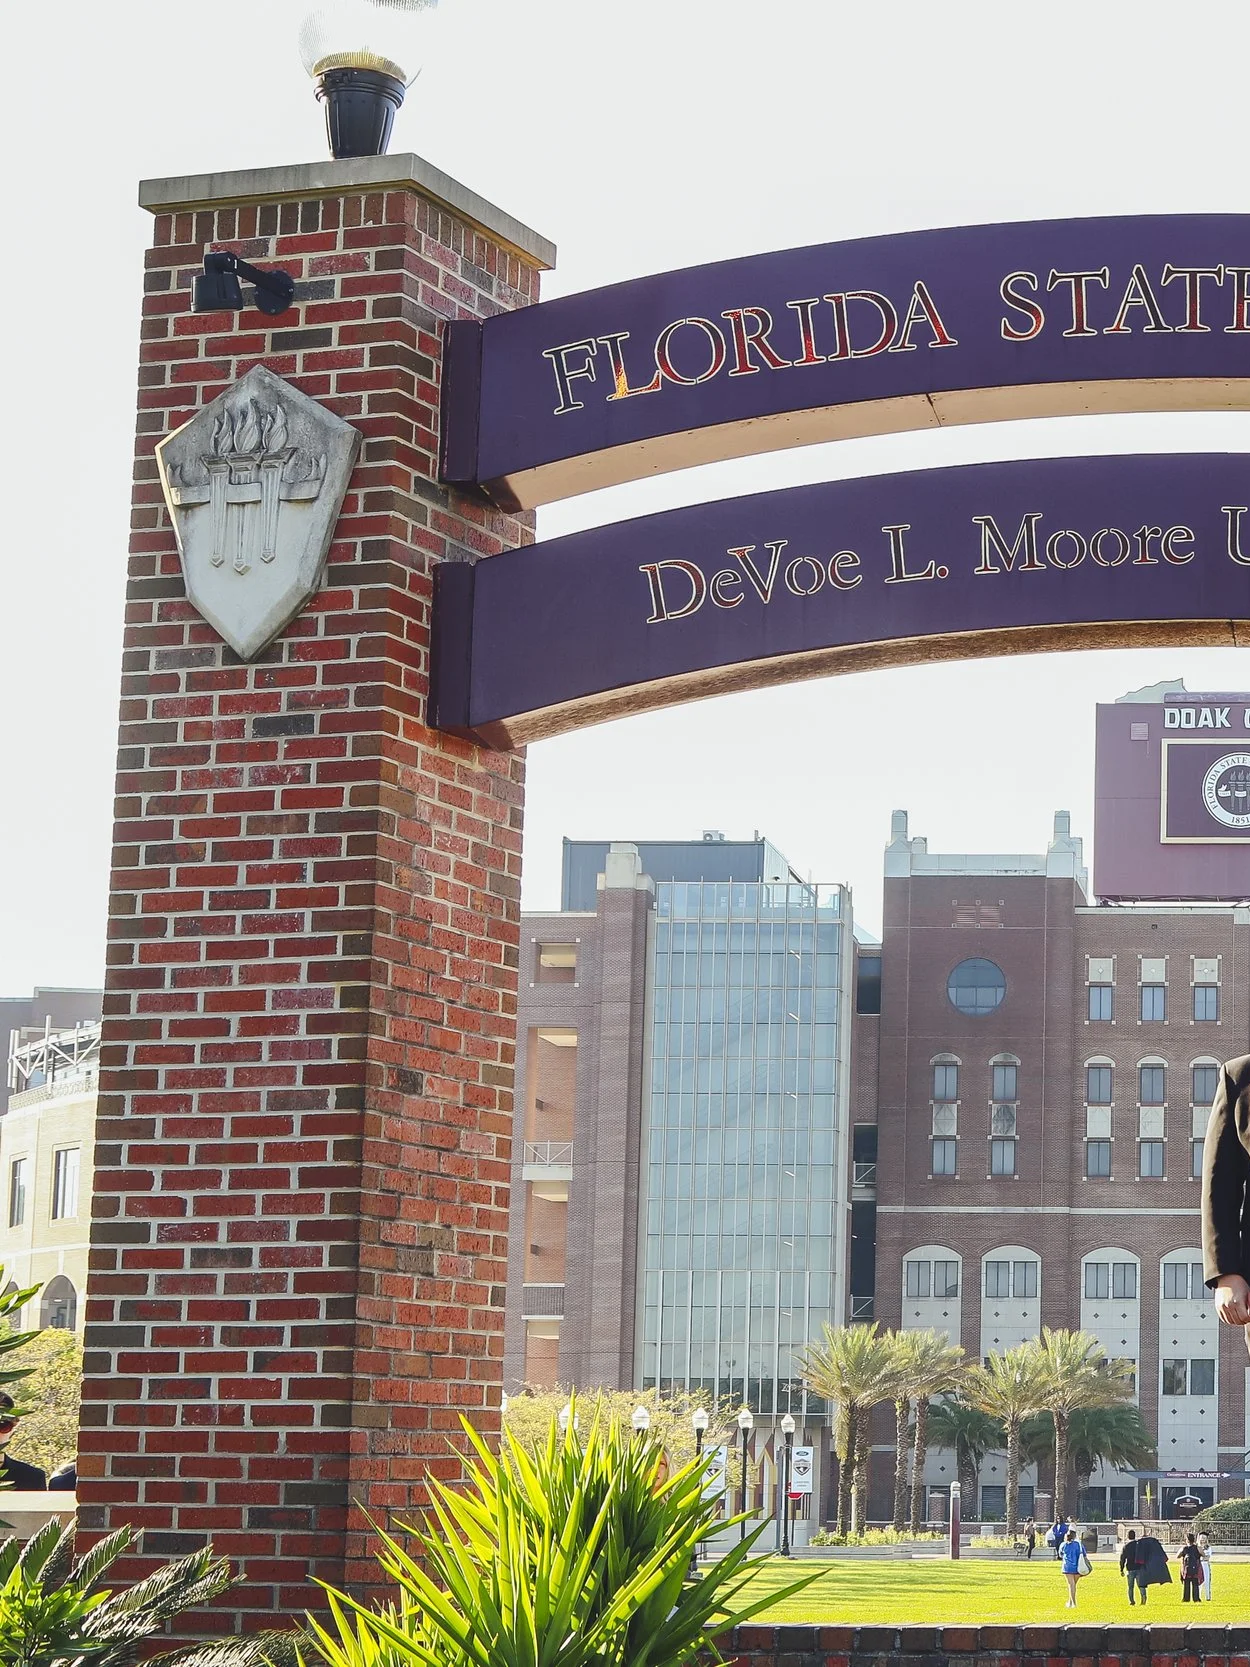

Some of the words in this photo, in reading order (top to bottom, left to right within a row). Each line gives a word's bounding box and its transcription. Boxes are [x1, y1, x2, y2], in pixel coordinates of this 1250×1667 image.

[542, 280, 958, 415] FLORIDA
[638, 540, 863, 625] DeVoe
[882, 524, 949, 585] L.
[973, 512, 1195, 576] Moore
[1163, 707, 1232, 729] DOAK
[1207, 769, 1220, 809] FLORIDA
[1220, 756, 1248, 769] STATE
[1231, 816, 1250, 824] 1851
